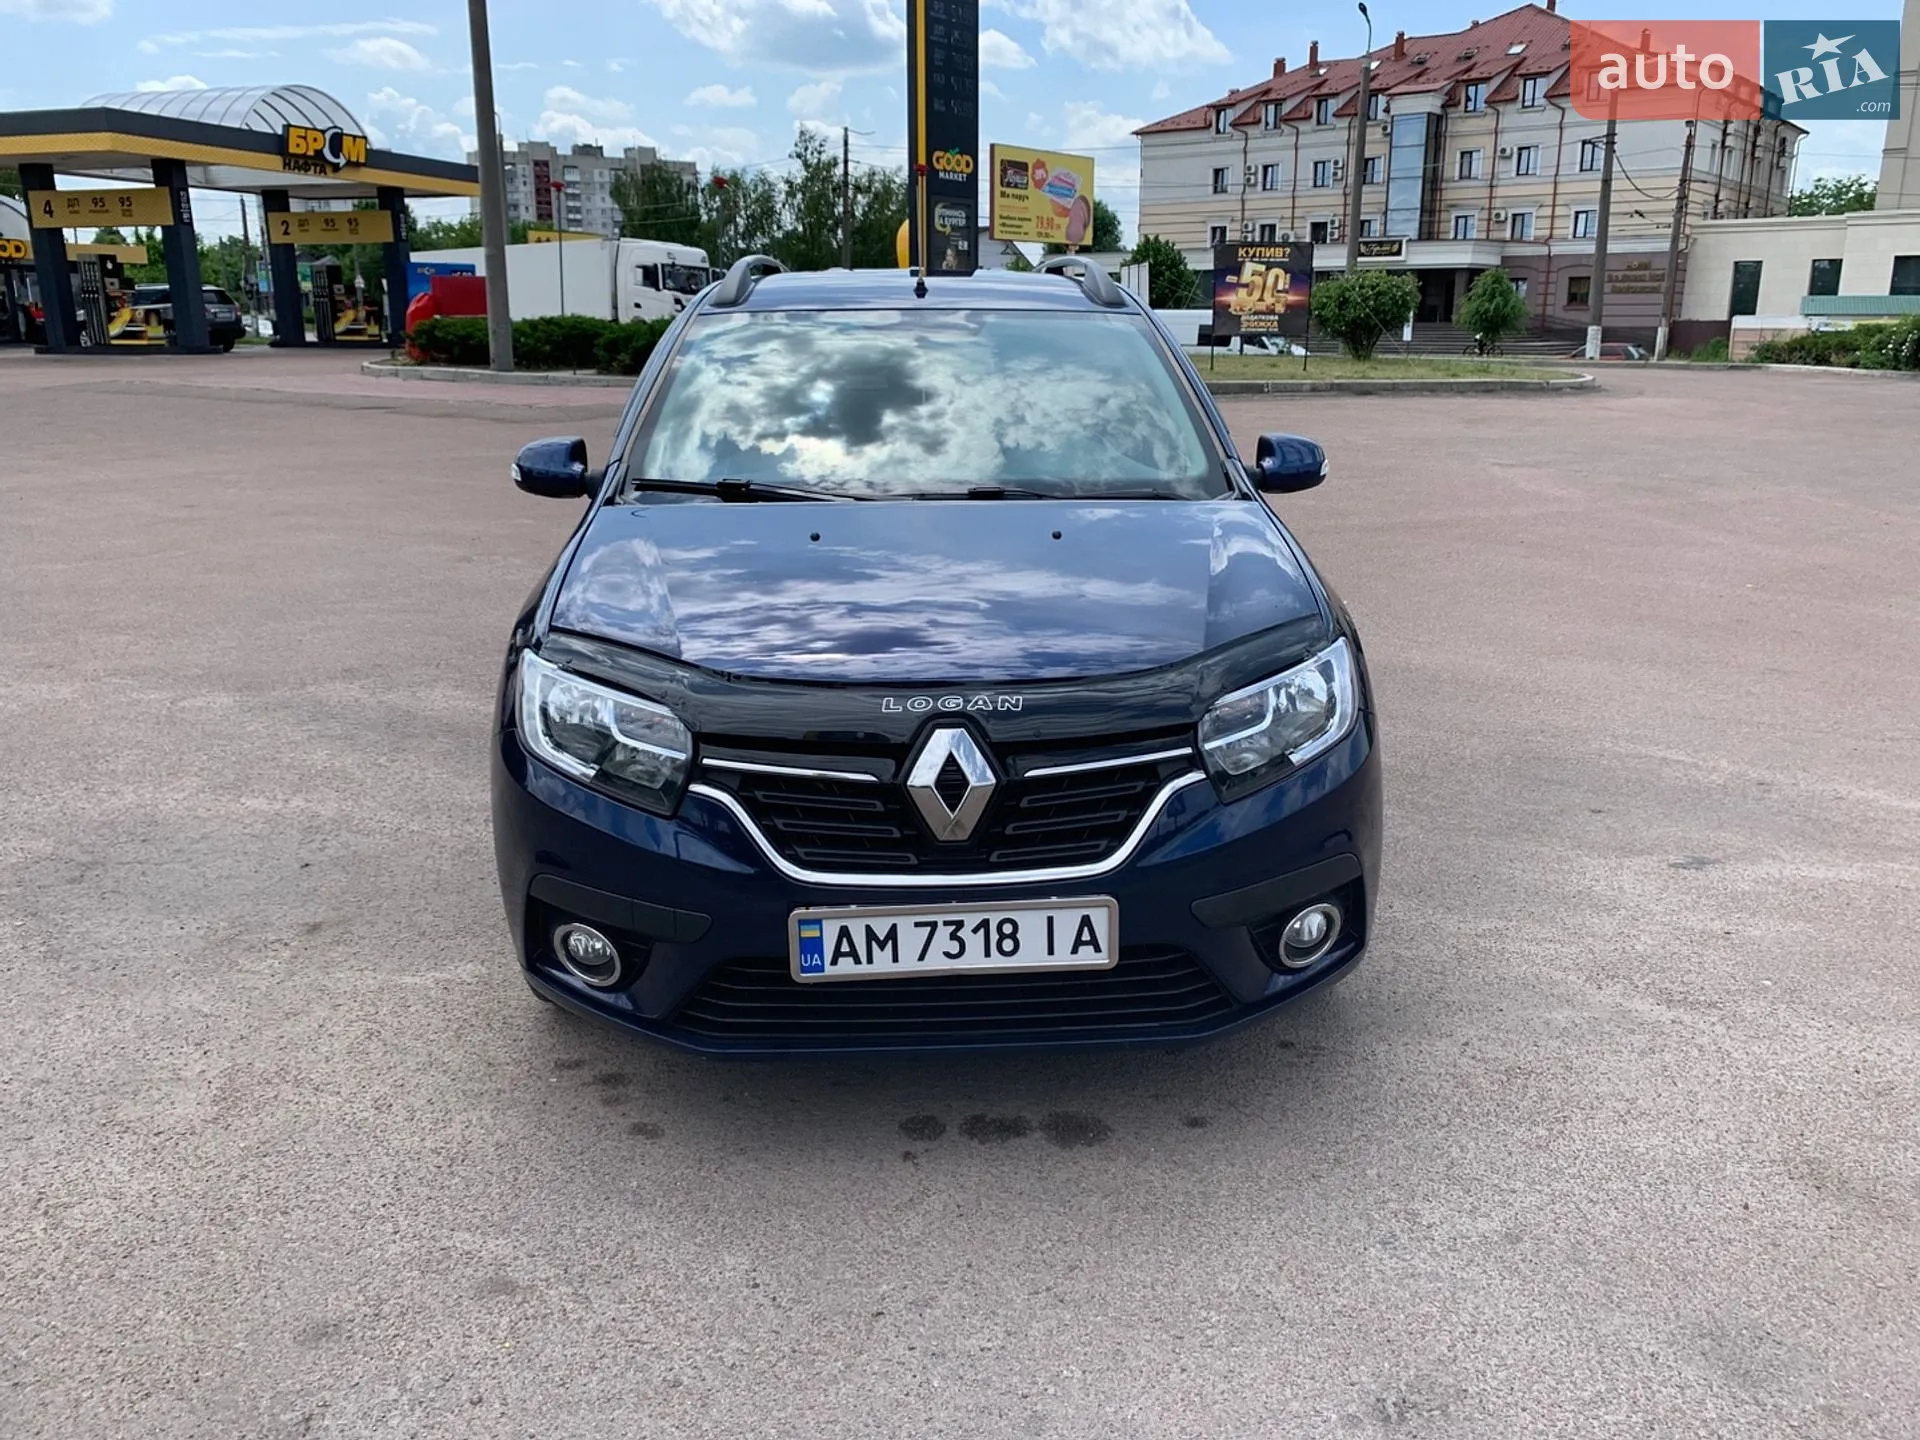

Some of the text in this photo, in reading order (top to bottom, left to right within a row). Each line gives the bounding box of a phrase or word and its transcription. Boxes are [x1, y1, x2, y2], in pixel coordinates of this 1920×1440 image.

[283, 158, 327, 175] НАФТА
[932, 150, 973, 174] GOOD
[939, 171, 967, 182] MARKET
[43, 199, 54, 218] 4
[91, 197, 106, 208] 95
[118, 196, 133, 207] 95
[281, 220, 291, 236] 2
[1238, 247, 1291, 258] КУПИВ?
[881, 695, 1023, 712] LOGAN
[829, 922, 900, 967] AM
[913, 916, 1021, 963] 7318
[801, 953, 821, 967] UA
